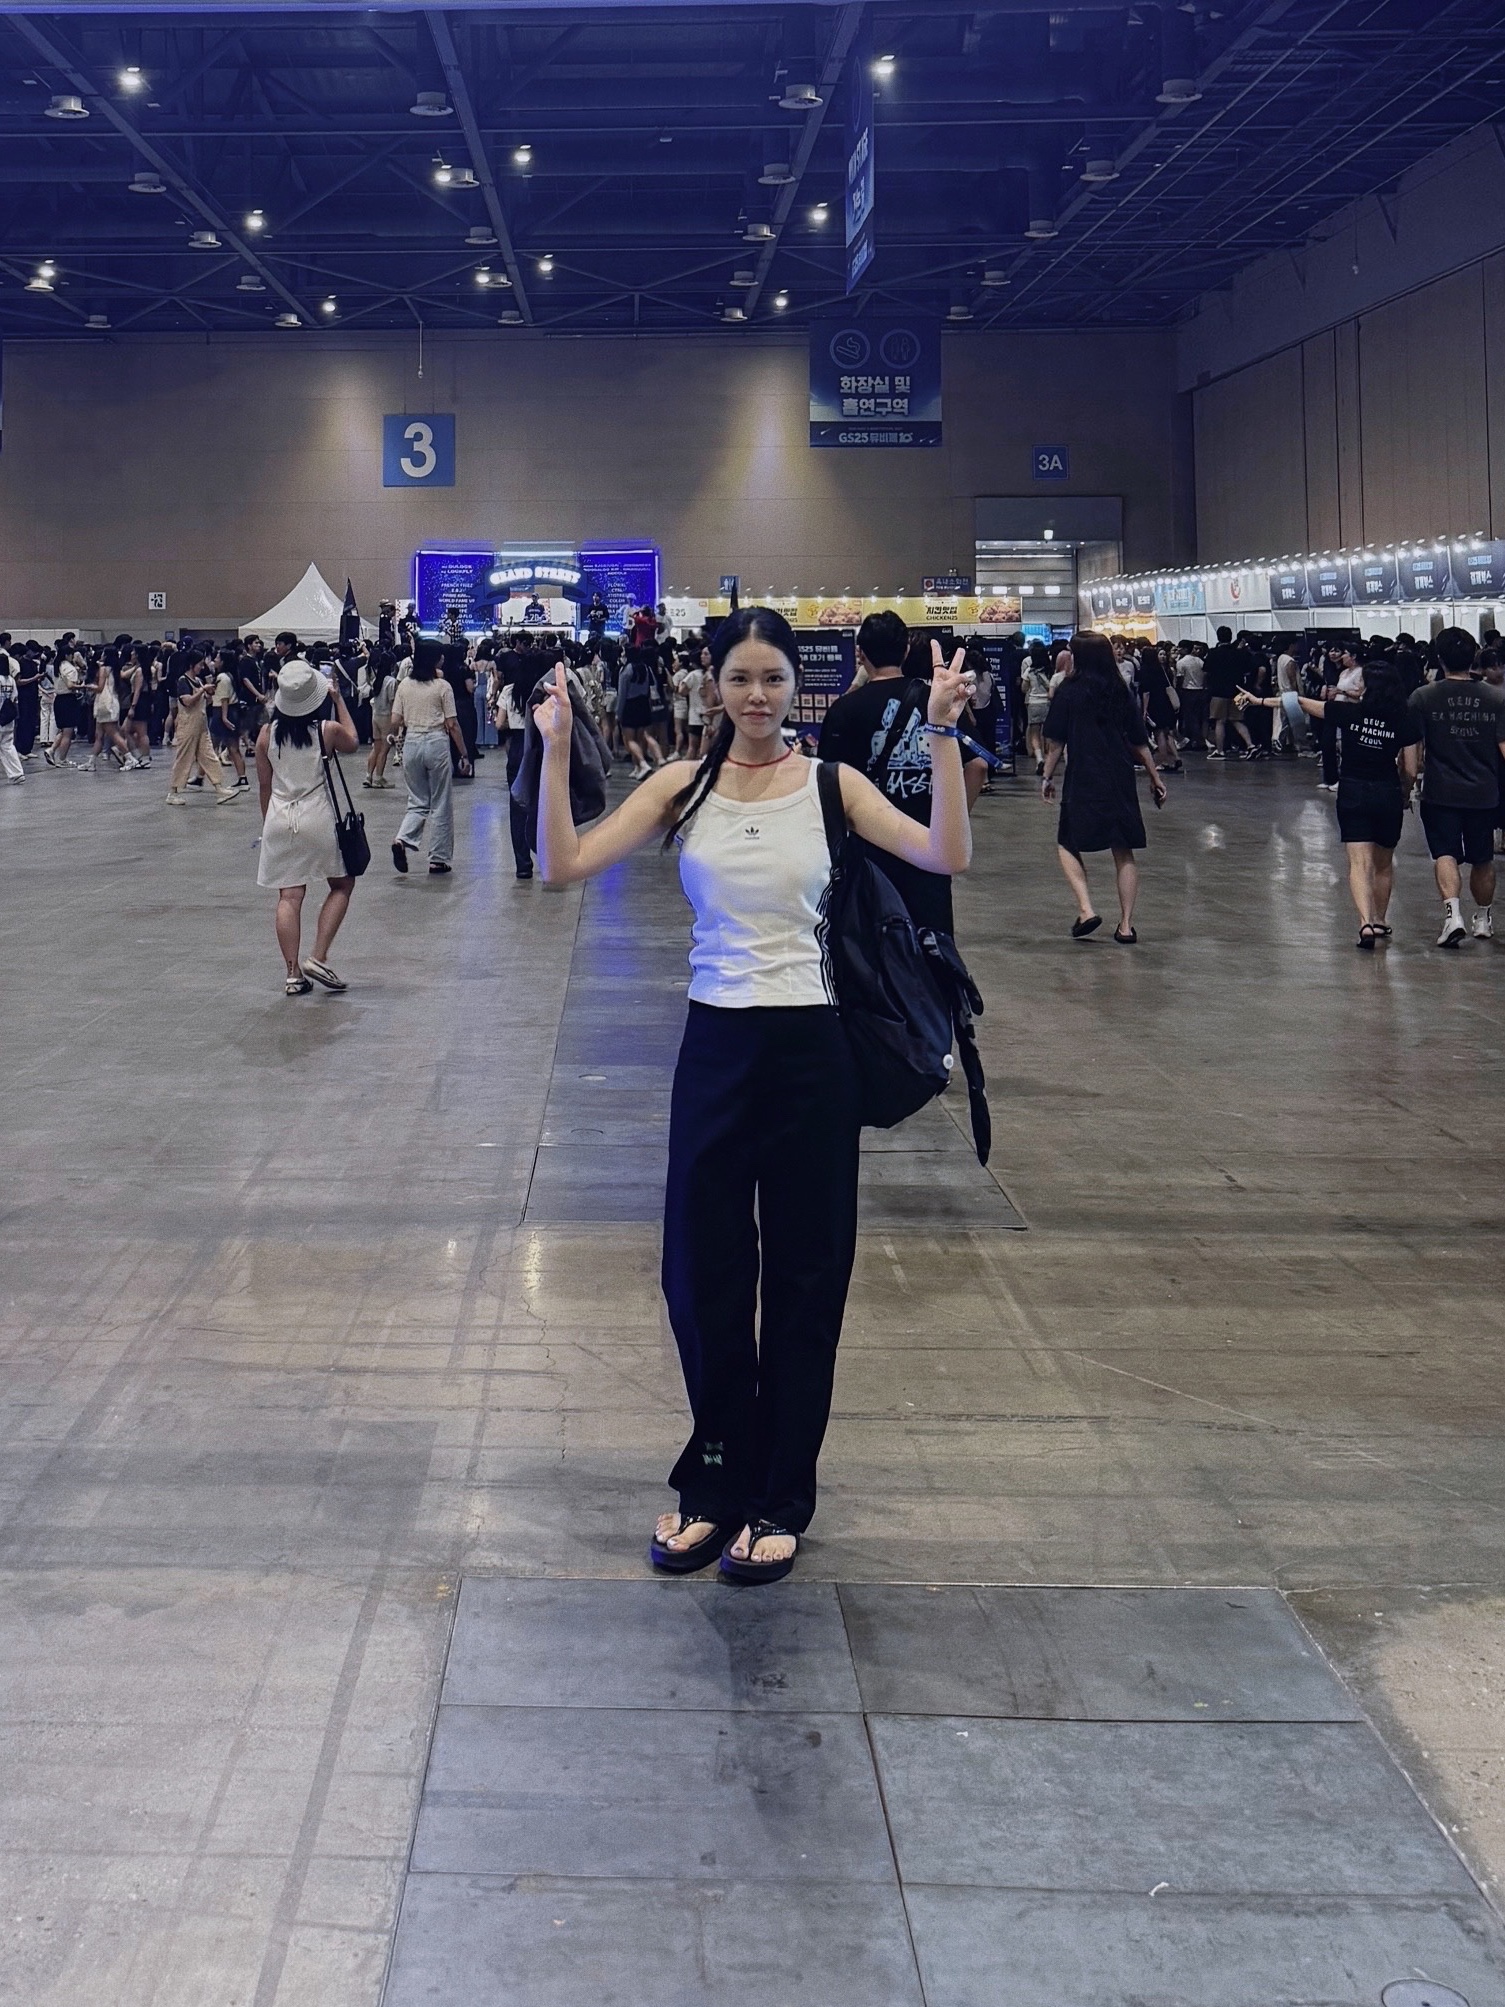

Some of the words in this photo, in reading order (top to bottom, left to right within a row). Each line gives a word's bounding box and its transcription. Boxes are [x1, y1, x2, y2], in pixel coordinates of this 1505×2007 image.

[840, 376, 889, 393] 화장실
[895, 376, 910, 393] 및
[843, 398, 908, 416] 흡연구역
[401, 422, 437, 478] 3
[1038, 454, 1063, 471] 3A
[925, 605, 957, 615] 치킨맛집
[1363, 717, 1386, 728] DEUS
[1432, 711, 1444, 722] EX
[1449, 711, 1496, 722] MACHINA
[1350, 723, 1359, 732] EX
[1362, 726, 1395, 739] MACHINA
[1359, 735, 1383, 745] SEOUL
